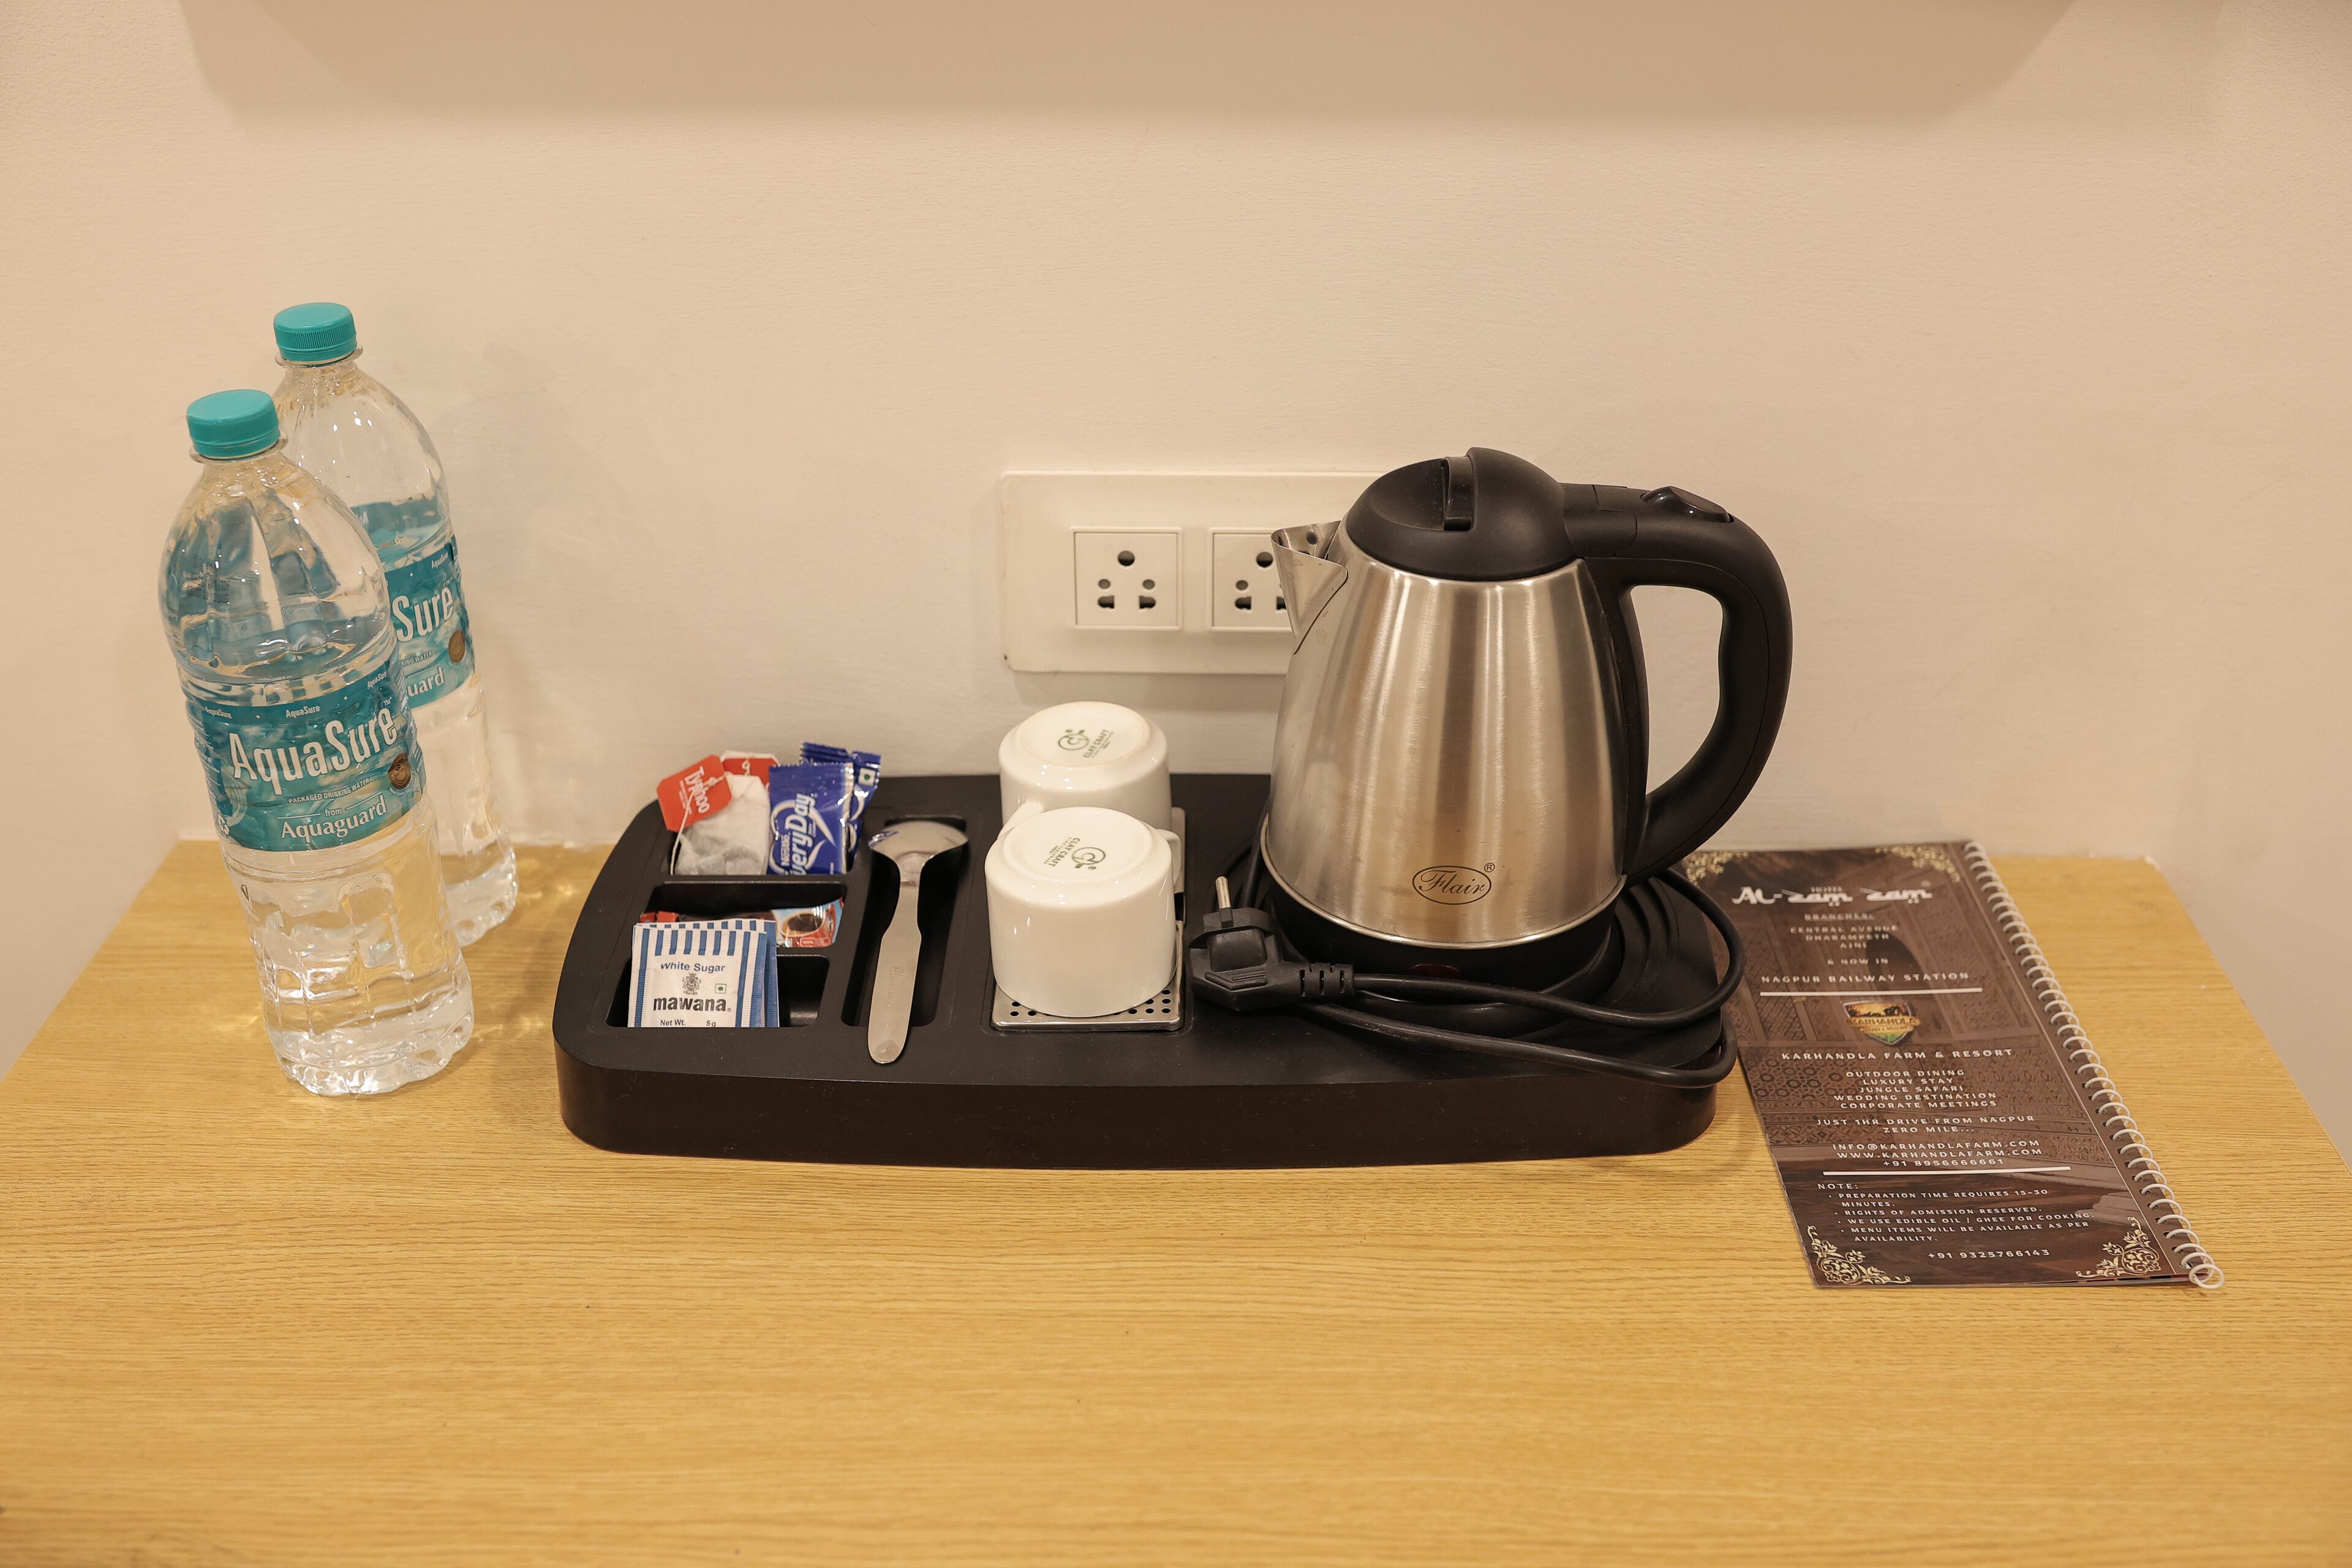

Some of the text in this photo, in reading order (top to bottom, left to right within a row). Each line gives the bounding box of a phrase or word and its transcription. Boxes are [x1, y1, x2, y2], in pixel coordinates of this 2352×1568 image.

[392, 587, 454, 642] Sure
[285, 705, 321, 718] AquaSure
[229, 708, 398, 795] AquaSure
[288, 778, 369, 804] PACKAGED DRINKING WATER
[281, 794, 388, 843] Aquaguard
[325, 808, 342, 817] from
[785, 793, 816, 875] veryDay
[1065, 837, 1080, 851] CLAY
[1048, 851, 1068, 867] CRAFT
[1419, 870, 1485, 894] Flair
[661, 961, 725, 974] White Sugar
[654, 997, 726, 1011] mawana
[1781, 1052, 1877, 1061] KARHANDLA
[1884, 1051, 1926, 1060] FARM
[1953, 1049, 2013, 1058] RESORT
[1904, 1092, 1997, 1101] DESTINATION
[1980, 1115, 2035, 1124] NAGPUR
[1832, 1140, 2040, 1151] INFO@KARHANDLAFARM.COM
[1836, 1148, 2043, 1159] WWW.KARHANDLAFARM.COM
[1960, 1249, 2050, 1259] 9325766143
